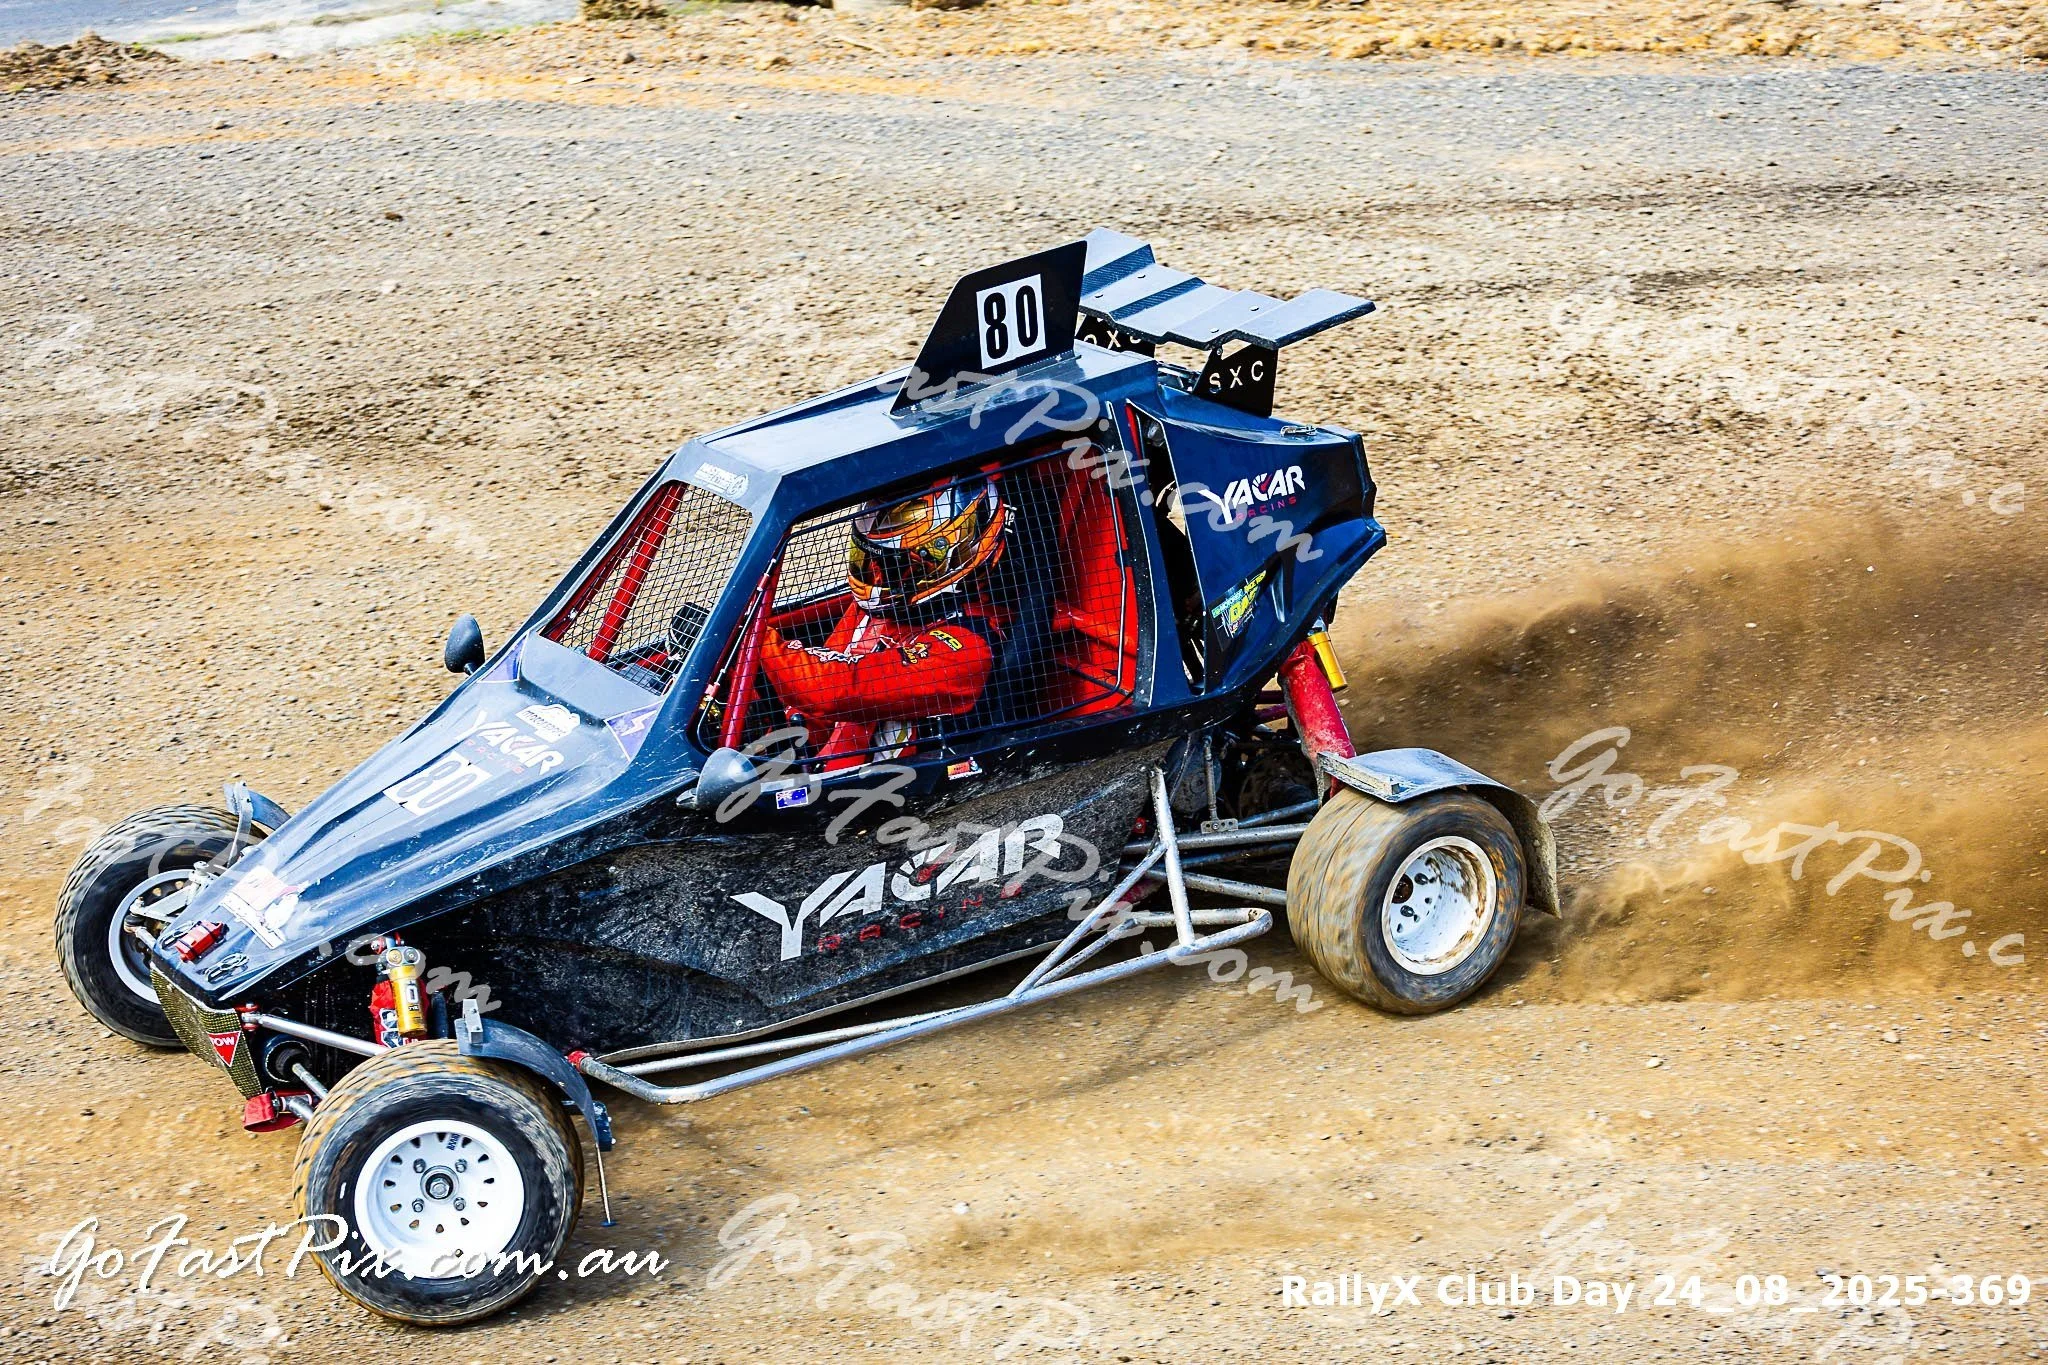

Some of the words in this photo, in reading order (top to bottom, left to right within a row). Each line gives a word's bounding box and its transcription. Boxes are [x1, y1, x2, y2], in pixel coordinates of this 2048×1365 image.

[984, 283, 1040, 359] 80
[1209, 360, 1264, 394] SXC
[1198, 465, 1306, 525] YACAR
[455, 709, 565, 776] YACAR
[396, 760, 478, 809] 80
[730, 813, 1063, 962] YACAR
